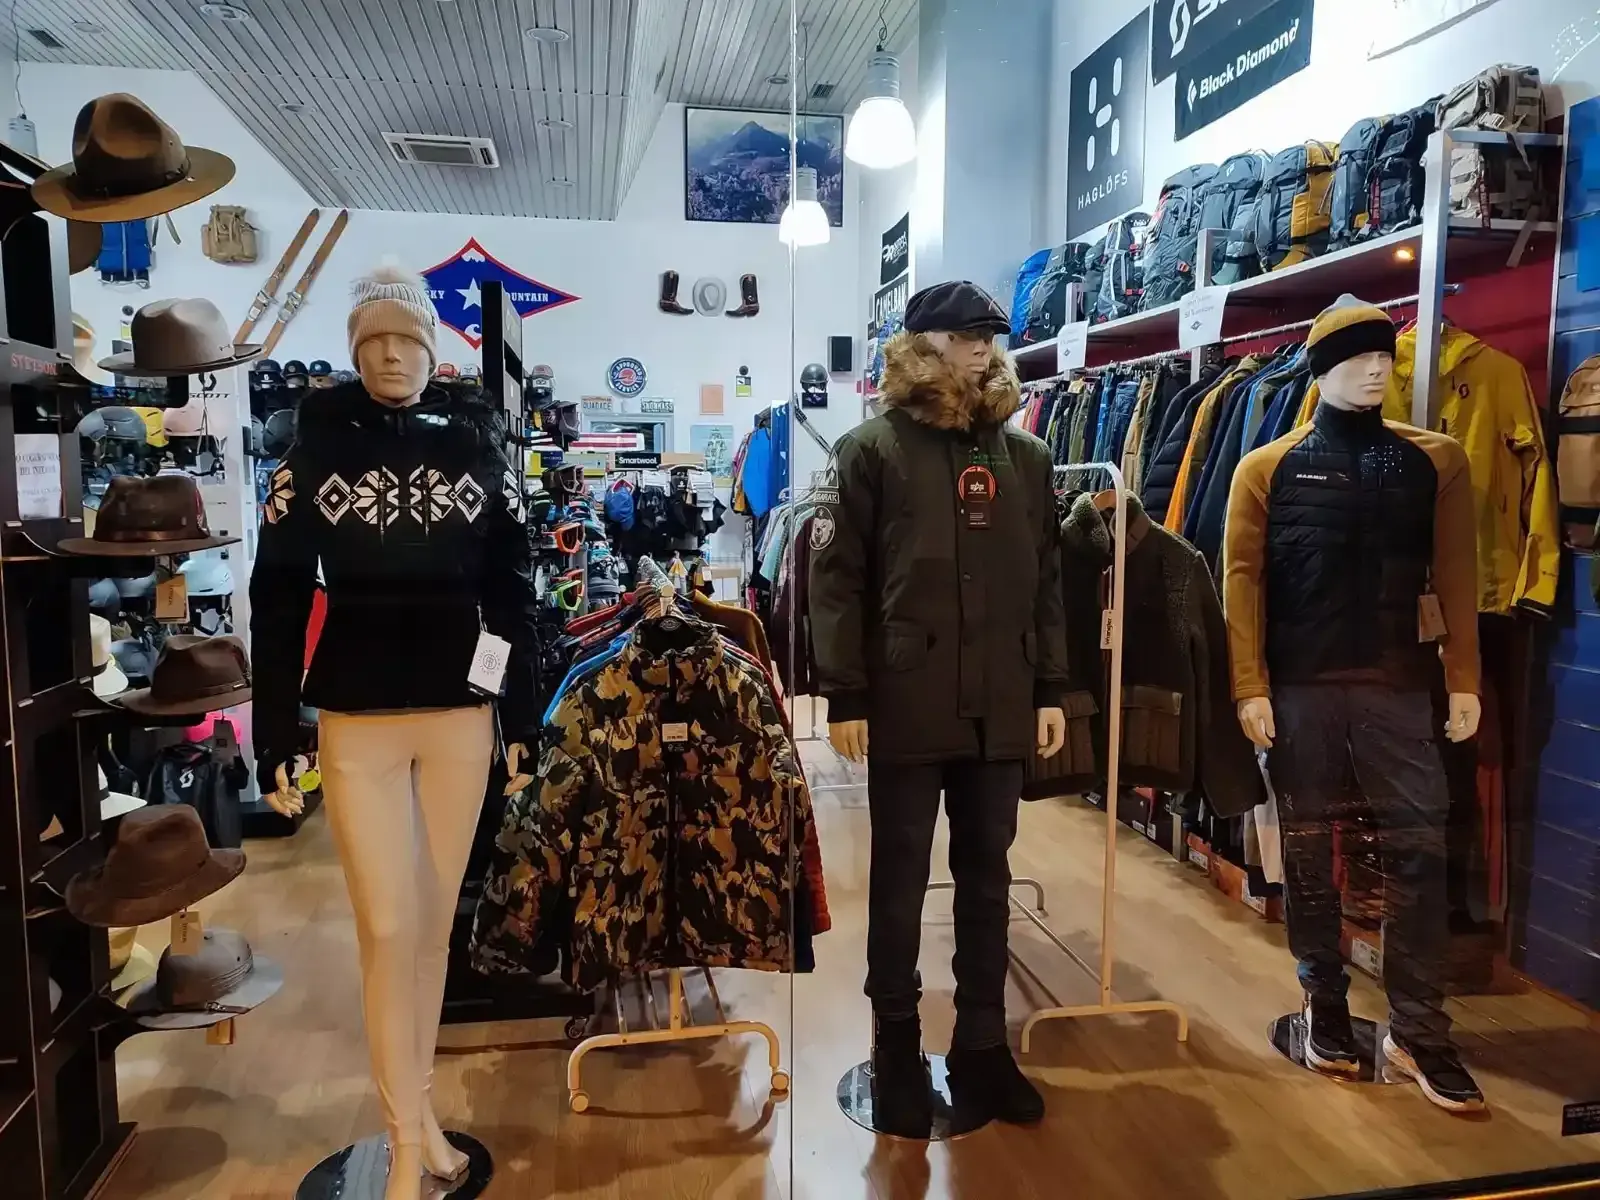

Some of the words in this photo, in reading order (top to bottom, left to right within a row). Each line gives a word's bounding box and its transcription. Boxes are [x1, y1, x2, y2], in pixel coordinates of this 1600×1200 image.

[1199, 64, 1235, 99] Black
[1236, 18, 1300, 78] Diamond
[1077, 169, 1128, 211] HAGLÖFS
[618, 456, 658, 465] Smartwool
[1105, 617, 1113, 645] Wrangler
